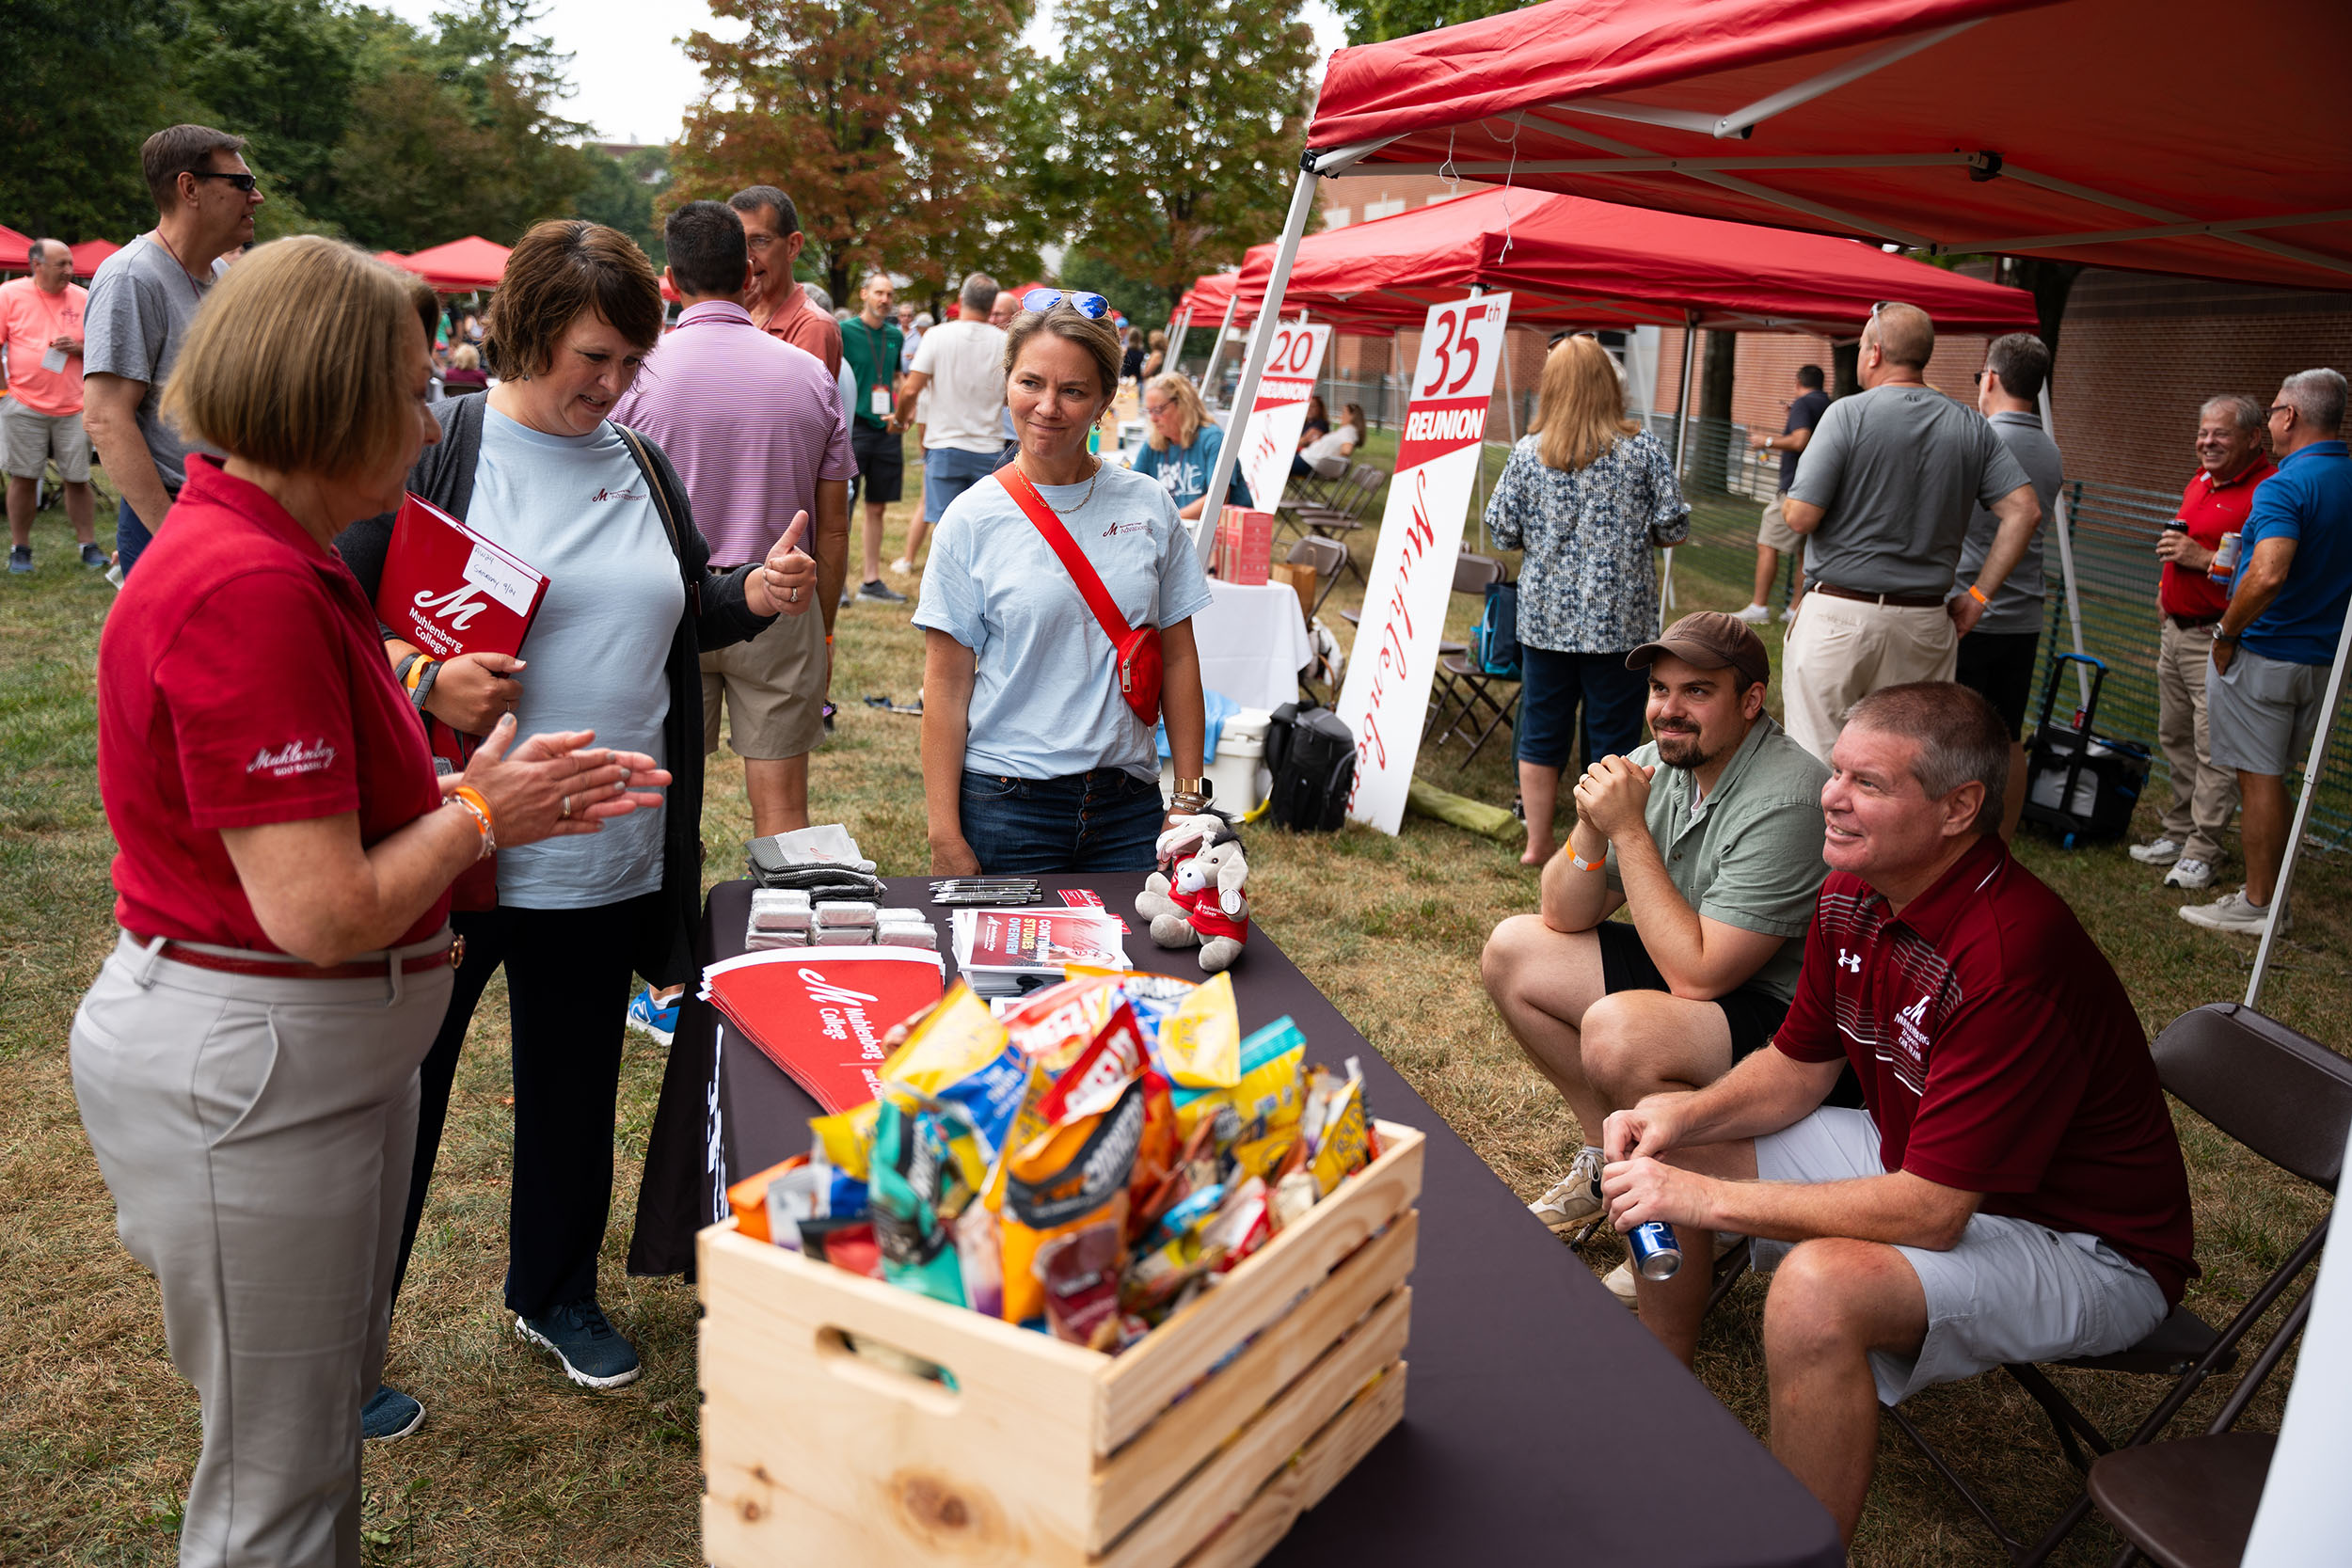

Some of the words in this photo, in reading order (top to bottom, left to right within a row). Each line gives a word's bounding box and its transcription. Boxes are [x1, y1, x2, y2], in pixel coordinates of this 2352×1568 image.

[1422, 301, 1502, 397] 35th
[1257, 380, 1314, 402] REUNION
[1405, 407, 1486, 442] REUNION
[592, 488, 608, 502] M
[1103, 522, 1118, 537] M
[408, 607, 464, 654] Muhlenberg
[415, 626, 448, 656] College
[1005, 917, 1022, 956] OVERVIEW
[1022, 918, 1037, 951] STUDIES
[798, 968, 880, 1007] M
[819, 1007, 849, 1040] College
[1902, 995, 1931, 1026] M
[843, 1007, 886, 1060] Muhlenberg
